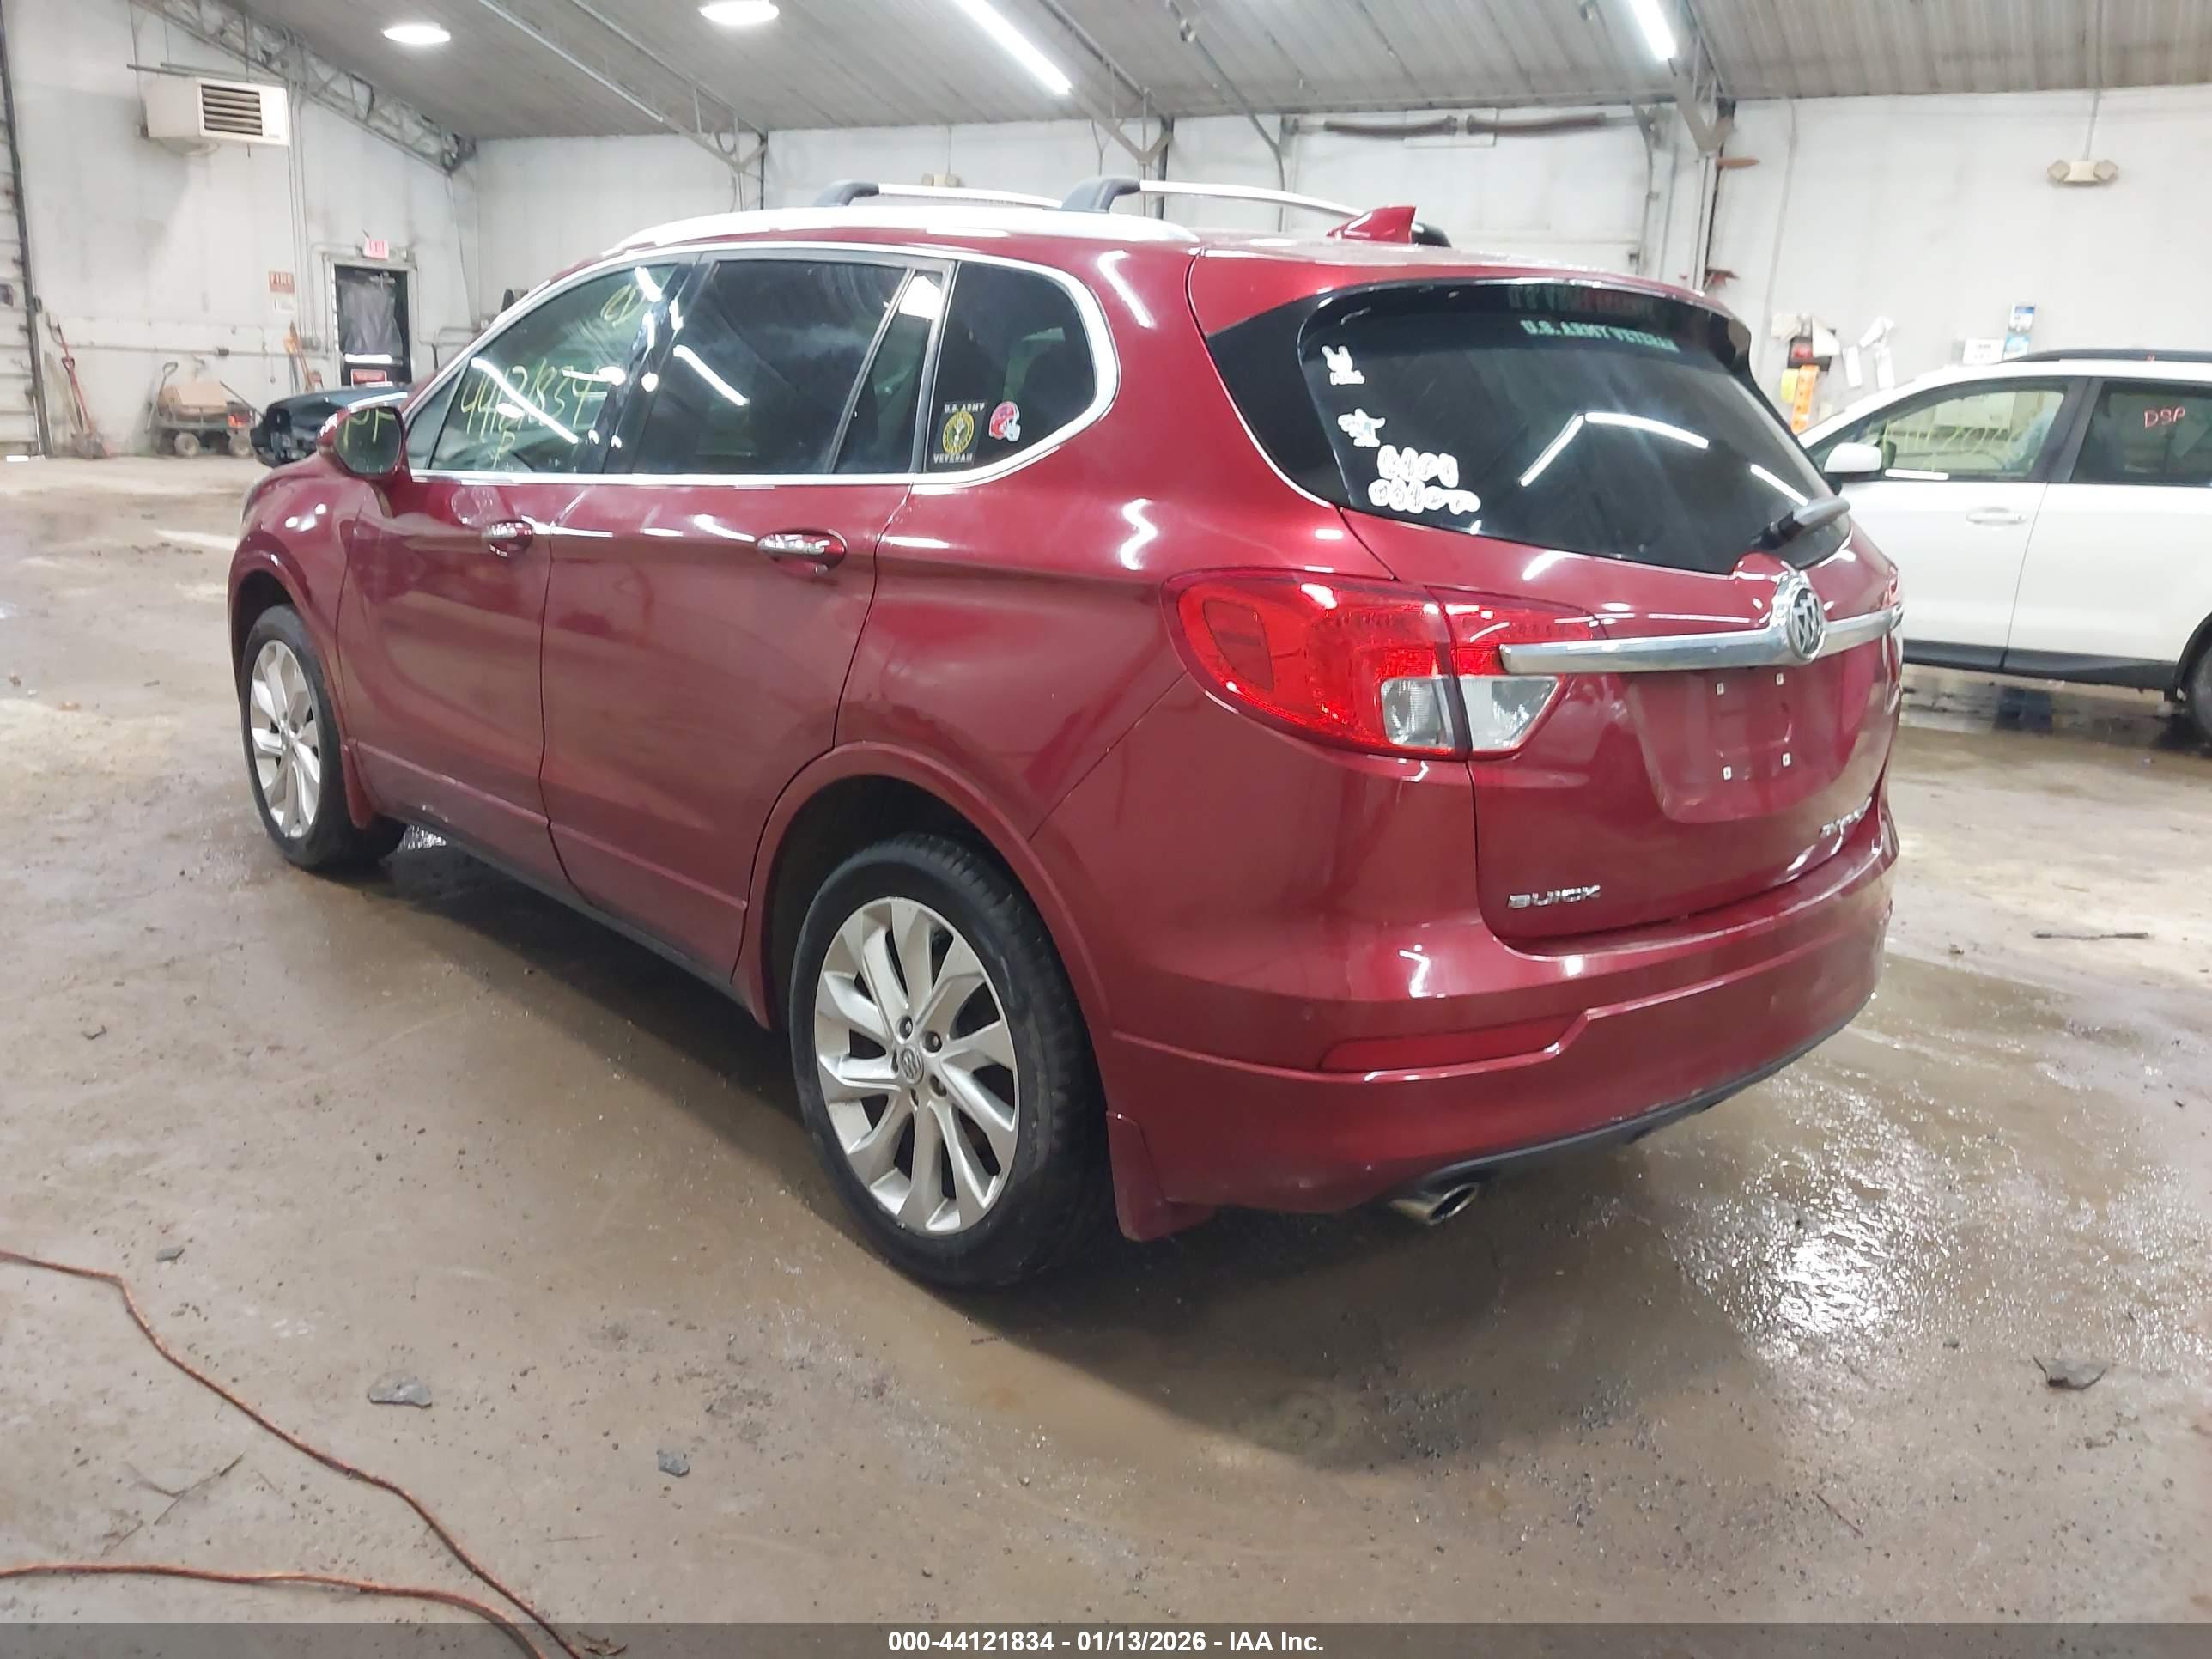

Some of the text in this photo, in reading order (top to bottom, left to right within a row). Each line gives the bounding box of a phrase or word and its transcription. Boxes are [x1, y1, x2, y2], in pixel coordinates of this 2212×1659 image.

[1560, 321, 1611, 338] ARMY
[1608, 327, 1680, 353] VETERAN
[960, 403, 985, 412] ARMY
[933, 453, 974, 464] VETERAN
[1508, 884, 1601, 908] BUICK
